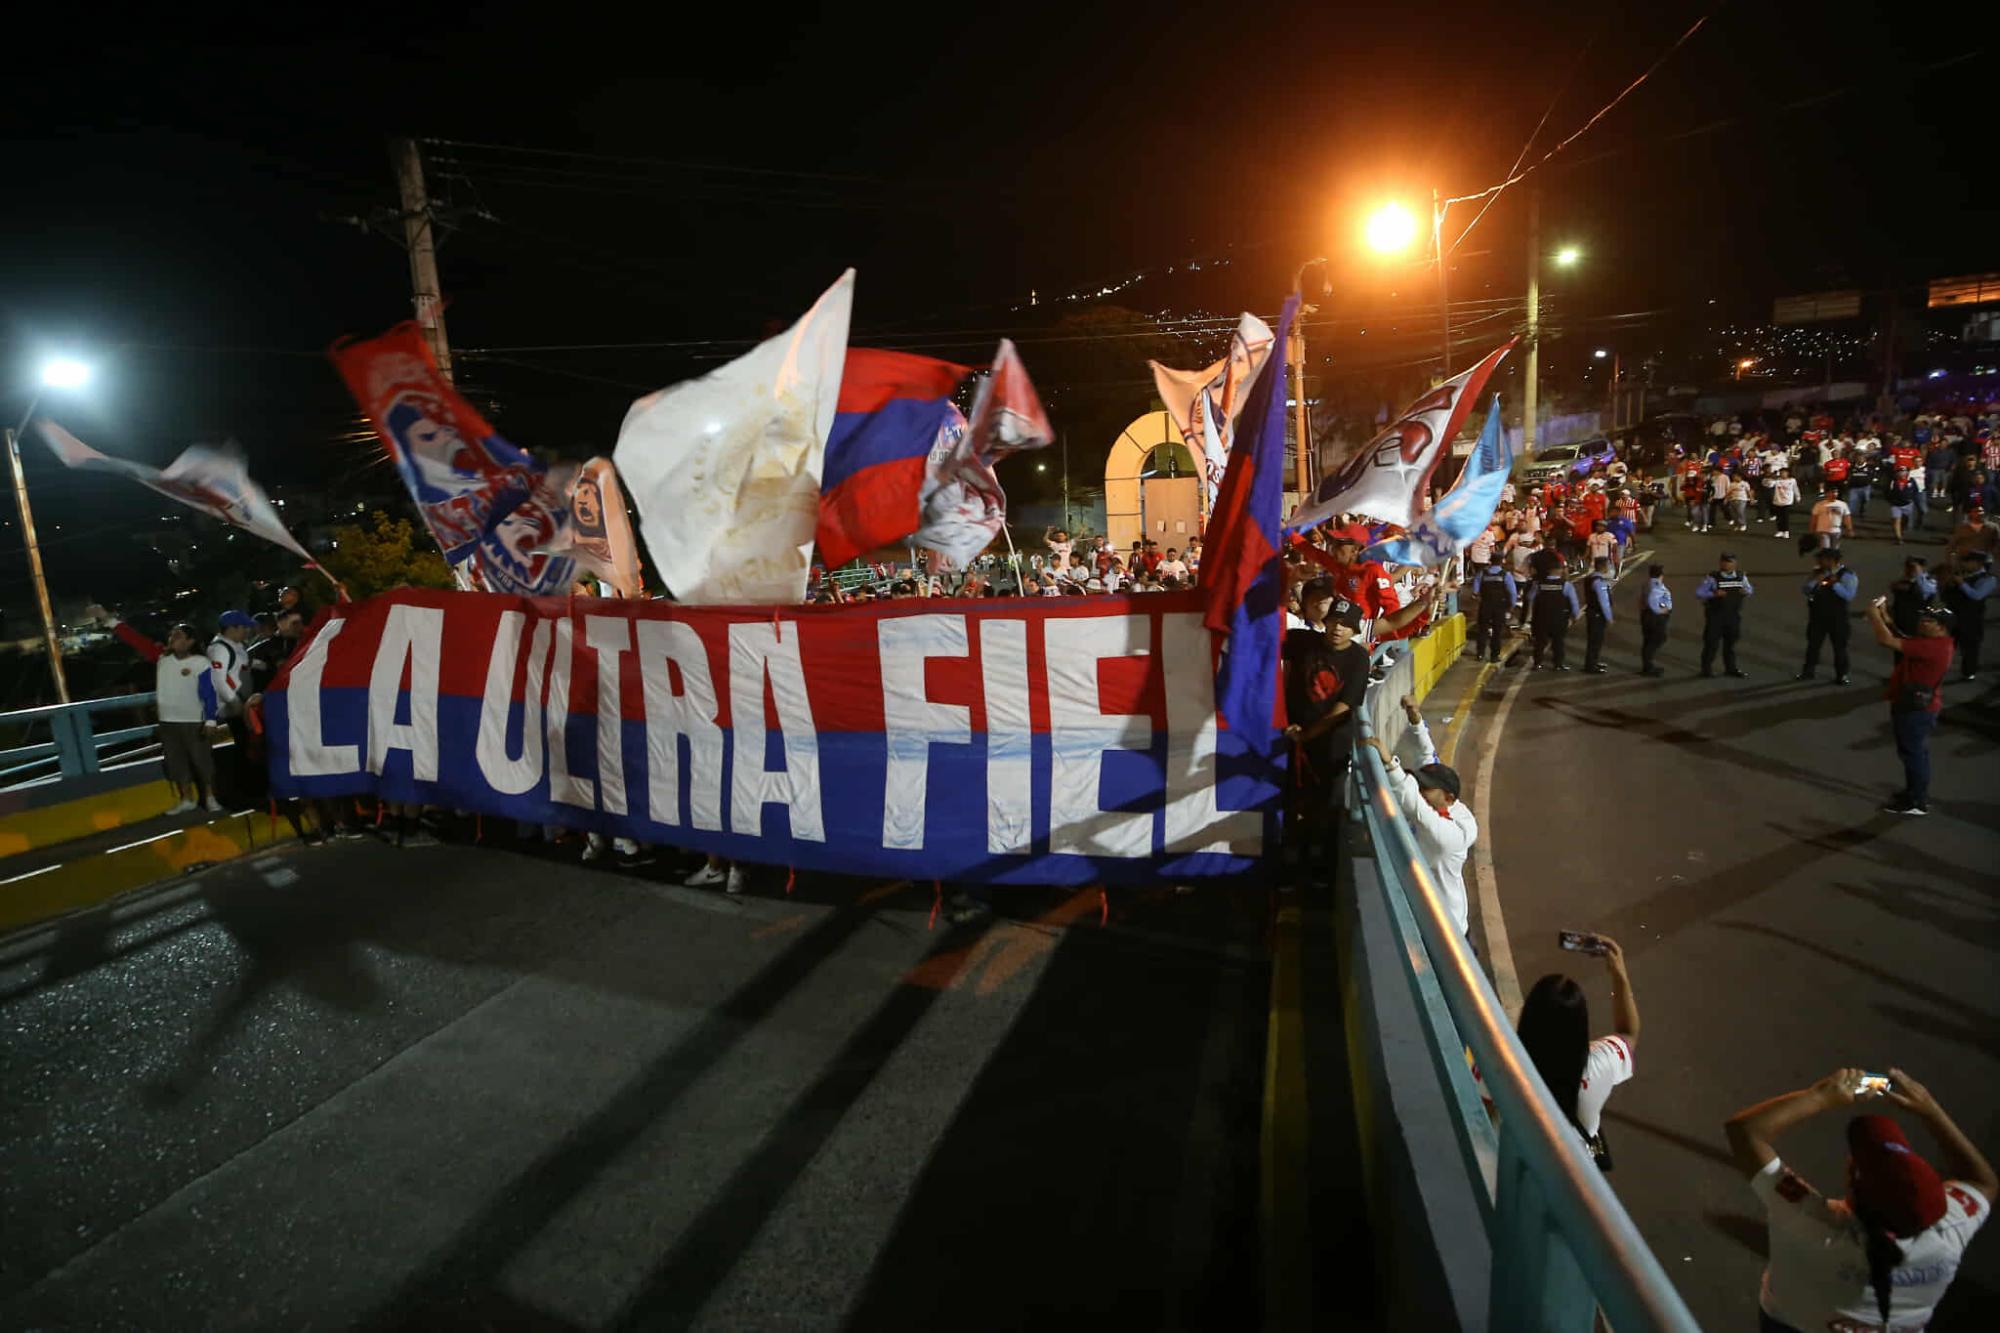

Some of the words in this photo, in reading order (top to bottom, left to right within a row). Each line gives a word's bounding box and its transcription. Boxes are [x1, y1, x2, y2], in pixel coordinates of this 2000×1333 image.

[287, 604, 444, 782] LA
[475, 610, 827, 843] ULTRA
[877, 612, 1263, 858] FIEL
